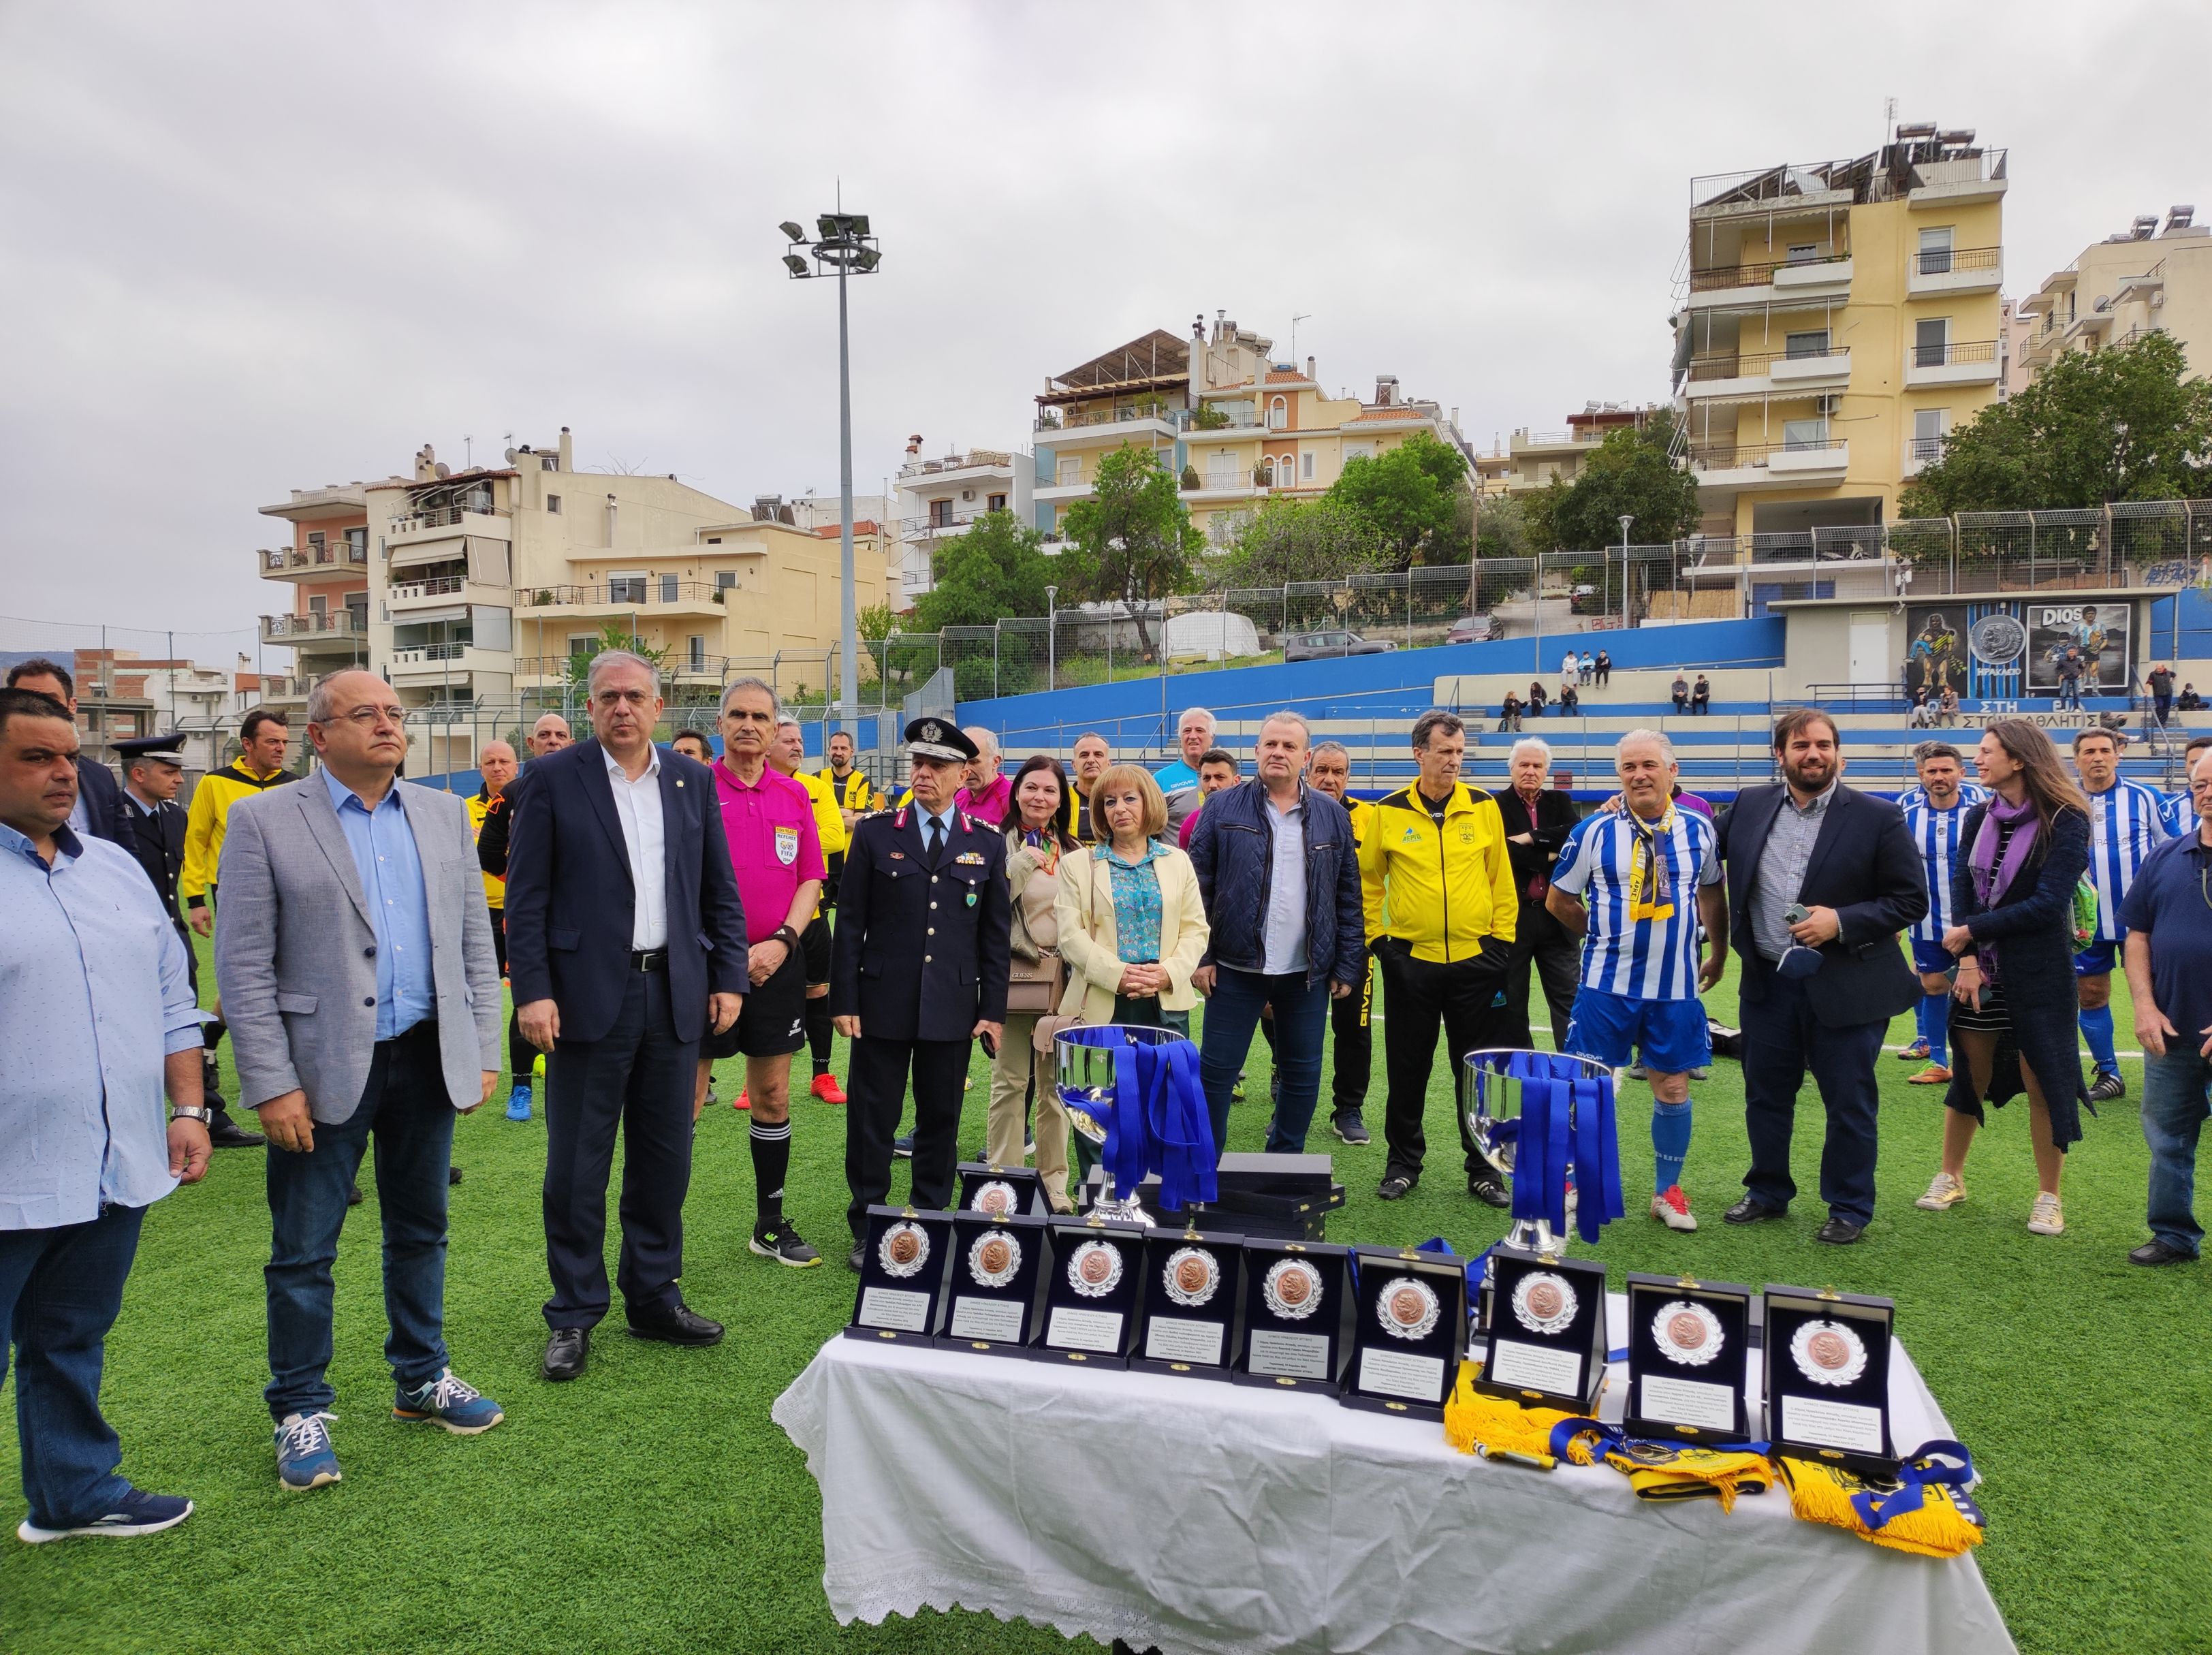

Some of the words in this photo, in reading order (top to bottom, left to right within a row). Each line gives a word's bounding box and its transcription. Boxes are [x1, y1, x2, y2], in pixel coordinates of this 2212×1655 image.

[2042, 609, 2082, 627] DIOS
[1980, 700, 2018, 713] ΣΤΗ
[1170, 780, 1195, 789] GIVOVA
[1360, 956, 1374, 1026] GIVOVA
[1576, 1051, 1603, 1060] GIVOVA
